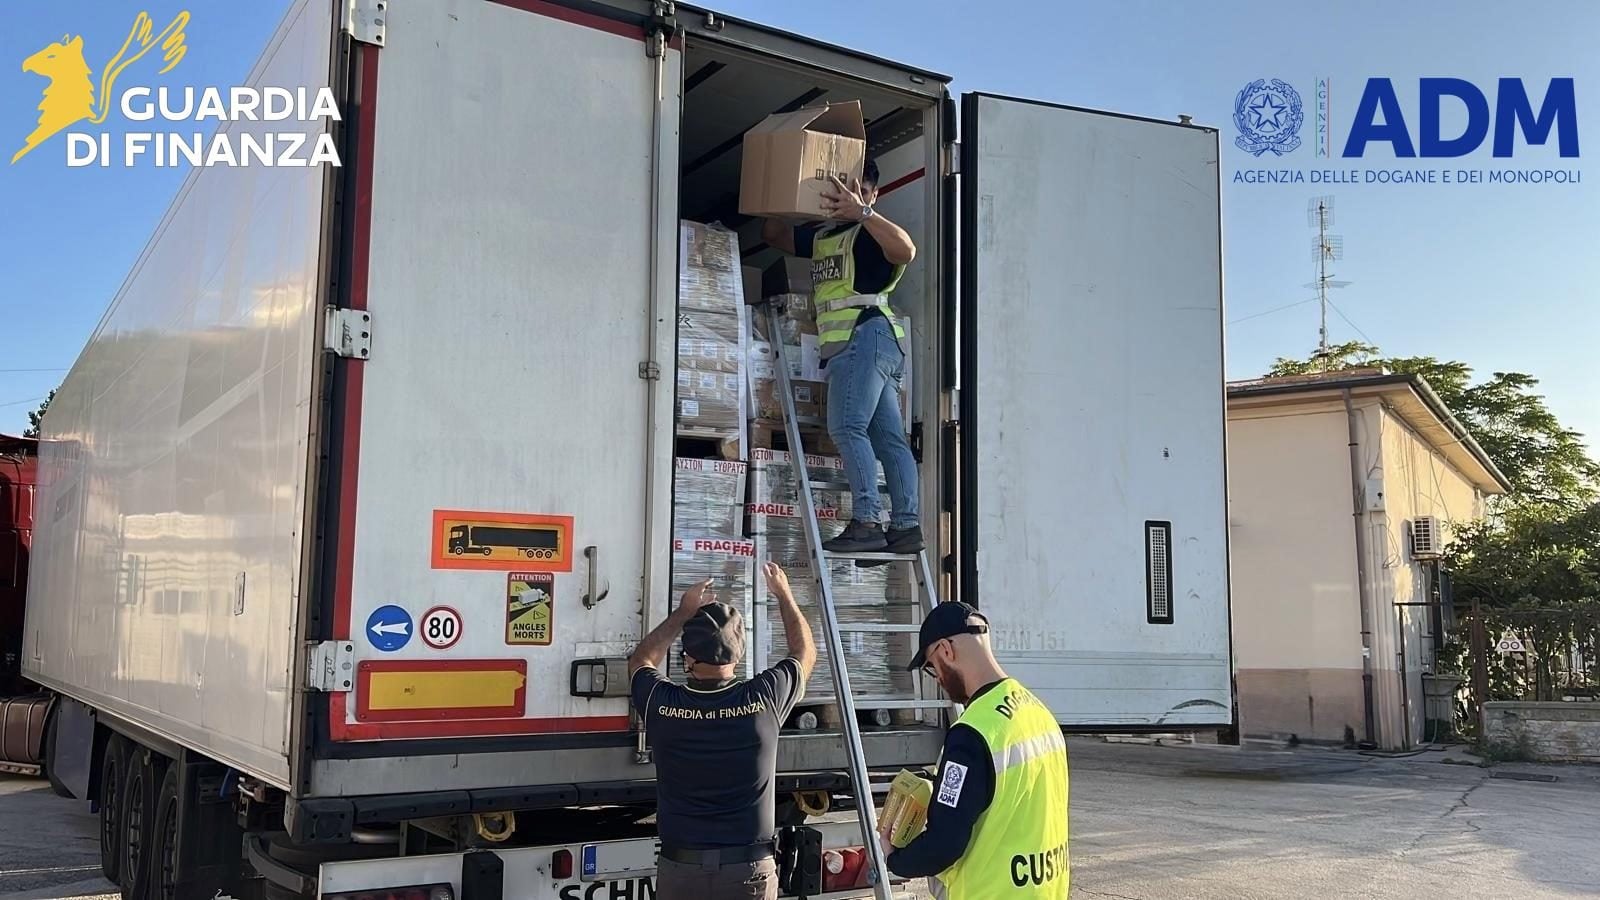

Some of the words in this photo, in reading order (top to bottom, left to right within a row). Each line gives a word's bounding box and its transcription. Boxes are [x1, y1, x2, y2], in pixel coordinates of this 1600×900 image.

[745, 503, 795, 516] FRAGILE
[510, 573, 552, 581] ATTENTION
[428, 616, 455, 639] 80
[512, 623, 546, 631] ANGLES
[514, 631, 545, 639] MORTS
[658, 705, 703, 719] GUARDIA
[706, 711, 716, 719] di
[719, 701, 766, 719] FINANZA
[585, 863, 595, 871] GR
